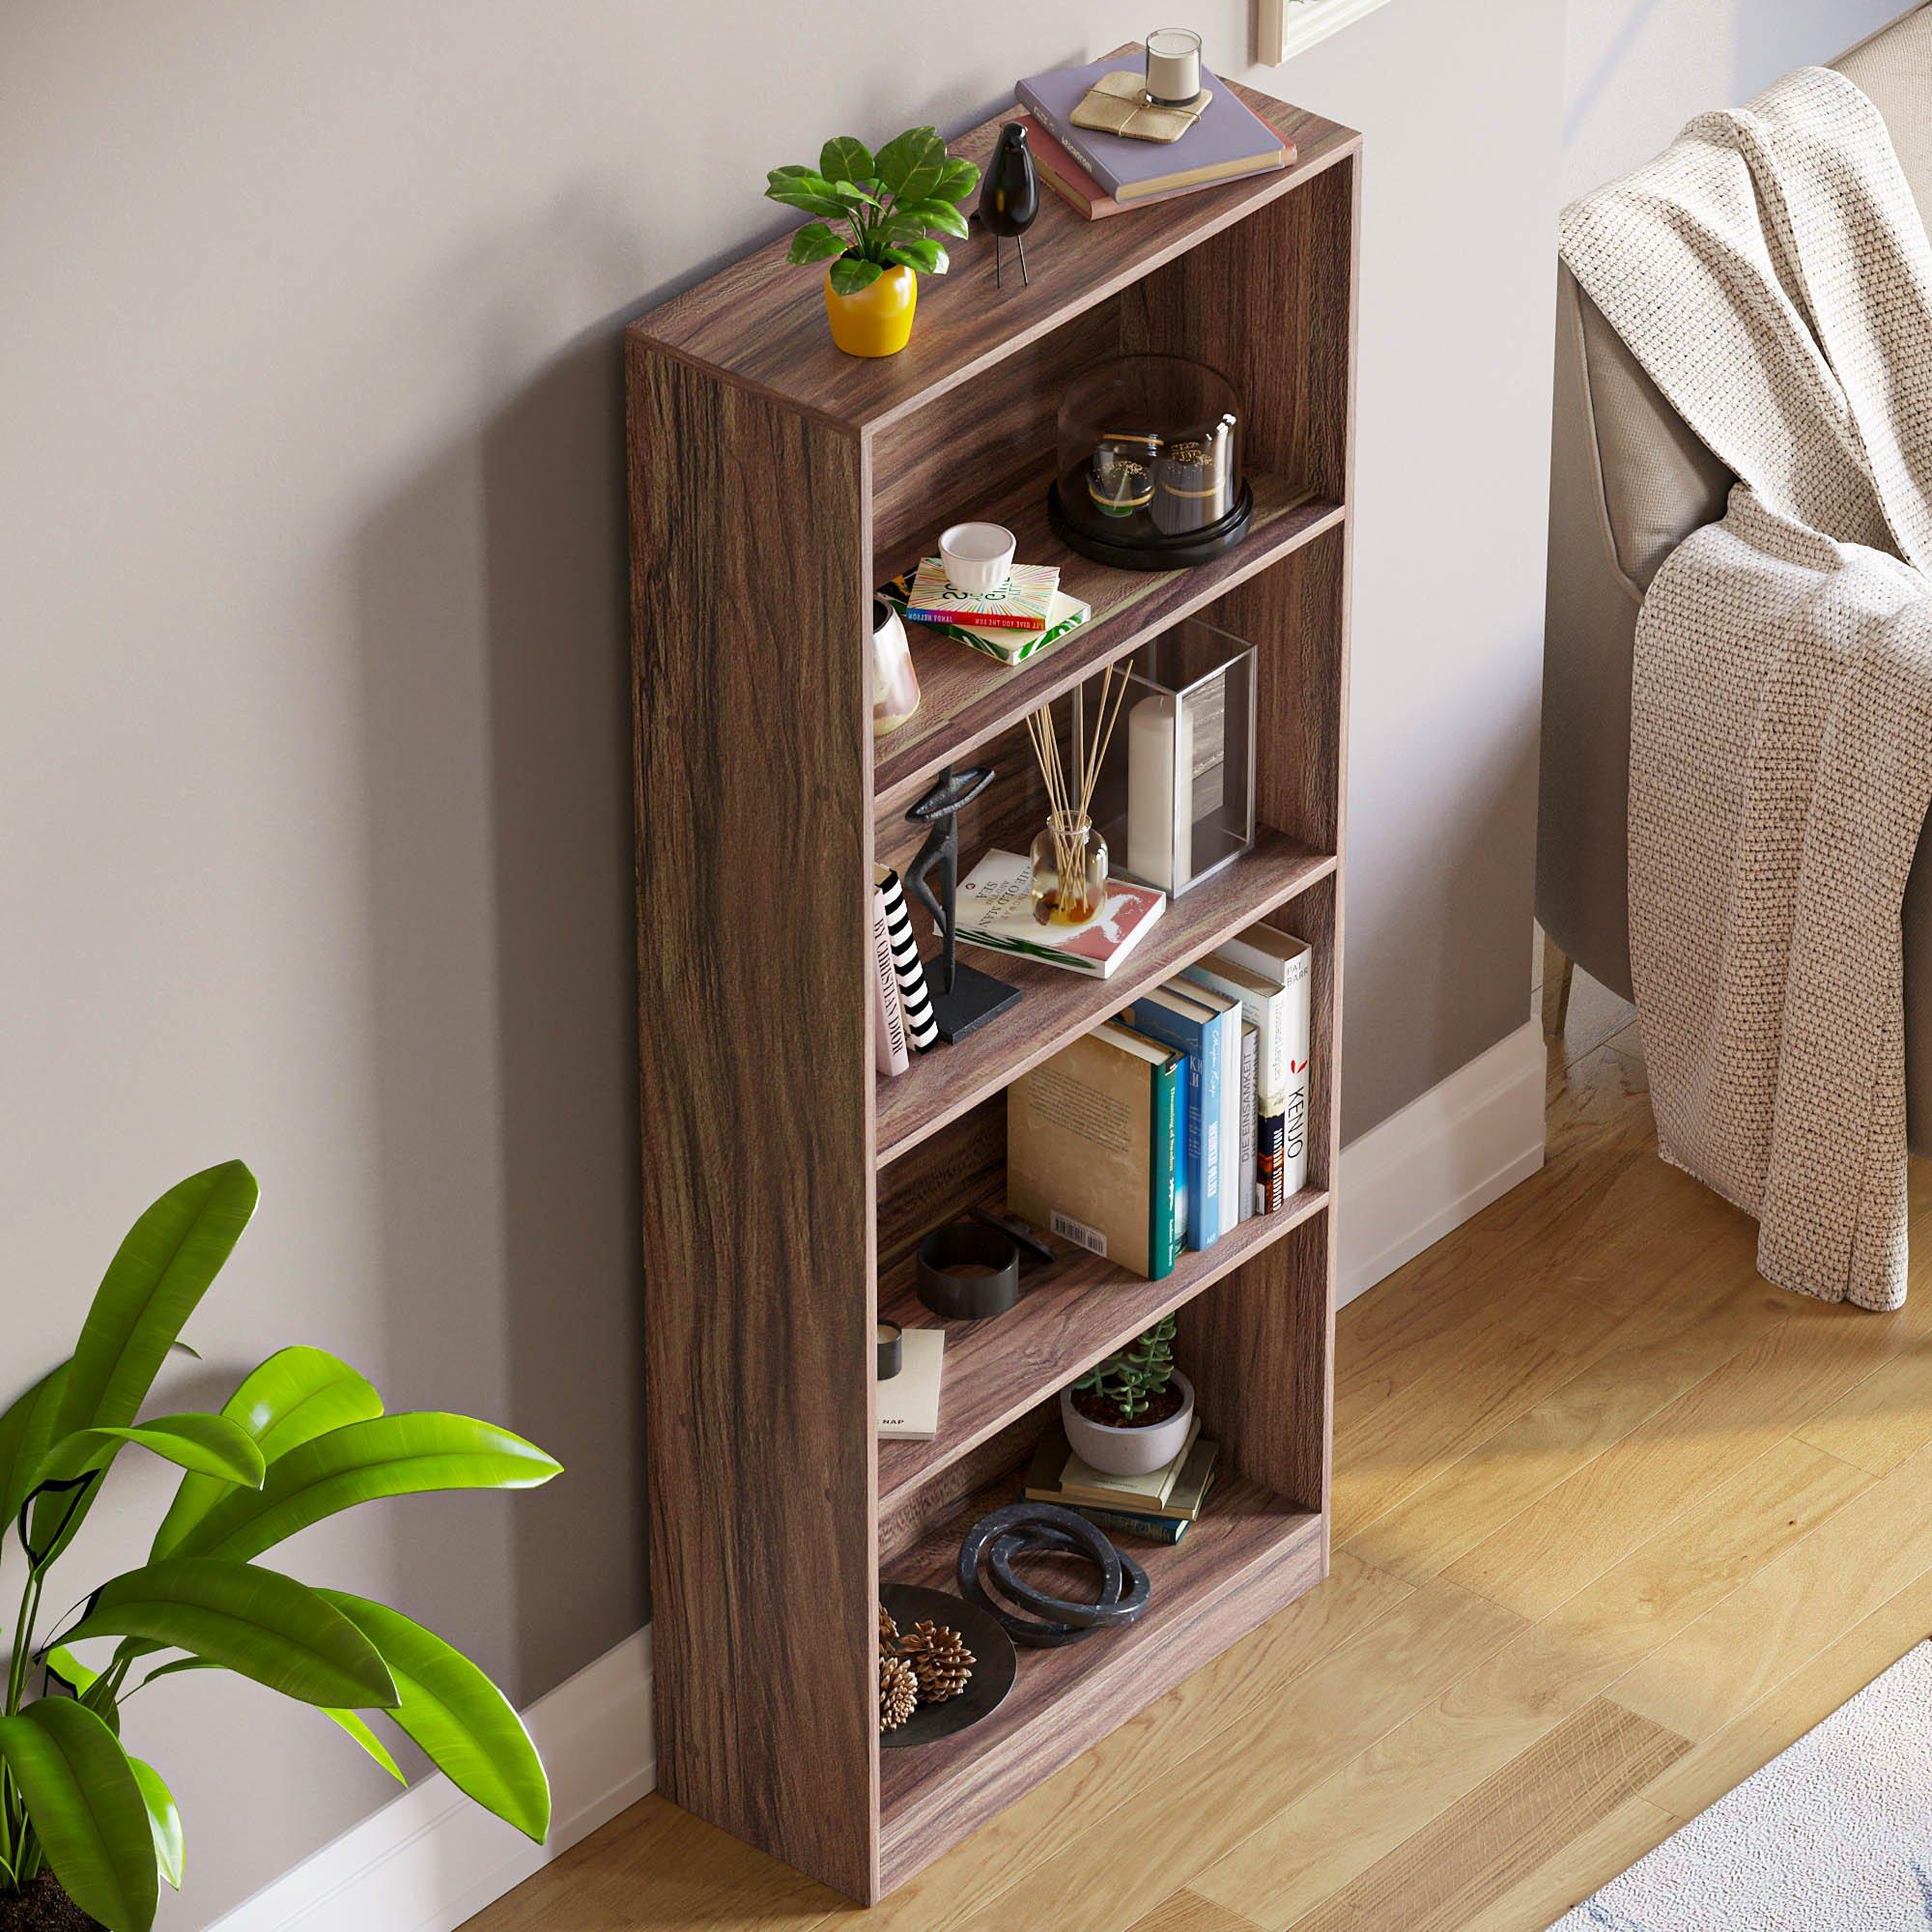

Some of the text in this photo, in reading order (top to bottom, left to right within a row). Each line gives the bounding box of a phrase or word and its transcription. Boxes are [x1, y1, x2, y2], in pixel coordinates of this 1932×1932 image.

[978, 905, 1002, 927] MAN
[998, 885, 1020, 905] OLD
[874, 919, 903, 1056] BY CHRISTIAN DIOR
[1241, 1053, 1252, 1163] DIE EINSAMKEIT
[1288, 1087, 1304, 1158] KENJO
